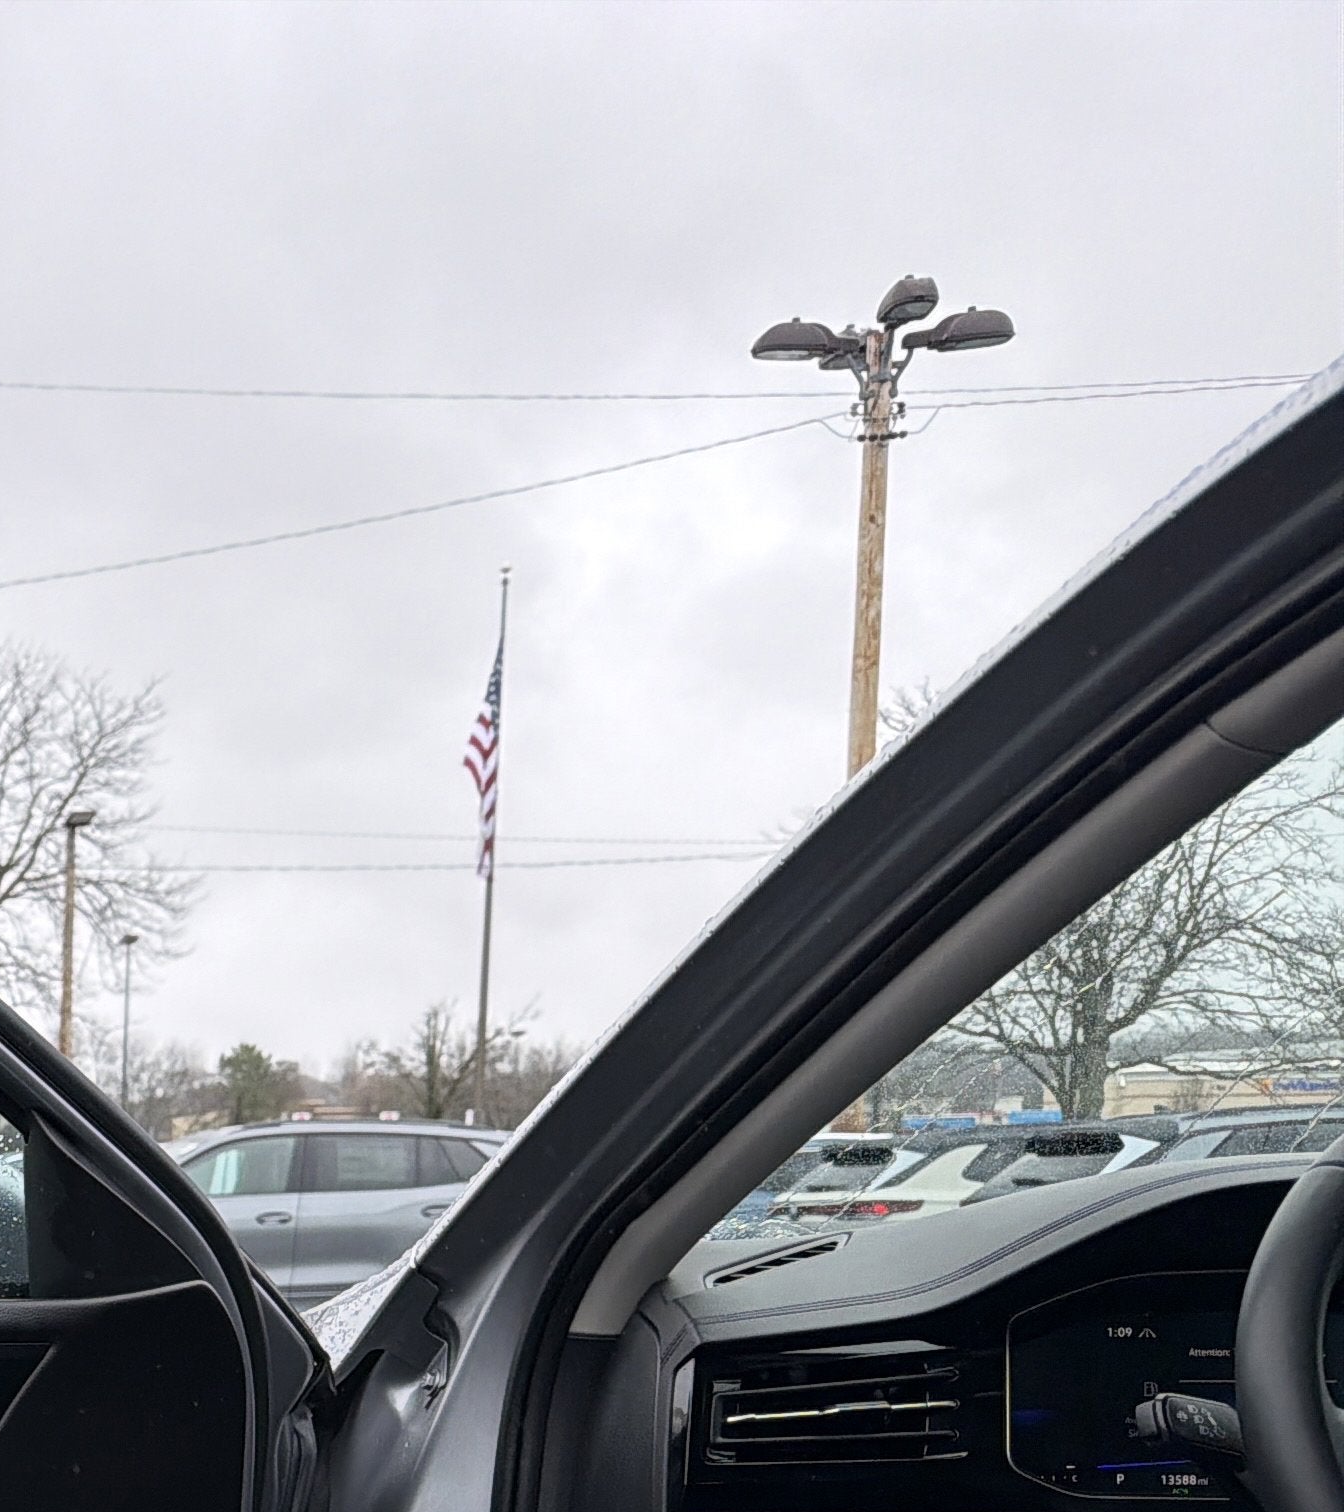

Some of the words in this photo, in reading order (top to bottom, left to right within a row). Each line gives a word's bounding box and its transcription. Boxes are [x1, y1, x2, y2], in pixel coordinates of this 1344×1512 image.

[1107, 1327, 1133, 1338] 1:09
[1116, 1473, 1125, 1485] P
[1161, 1474, 1197, 1486] 13588
